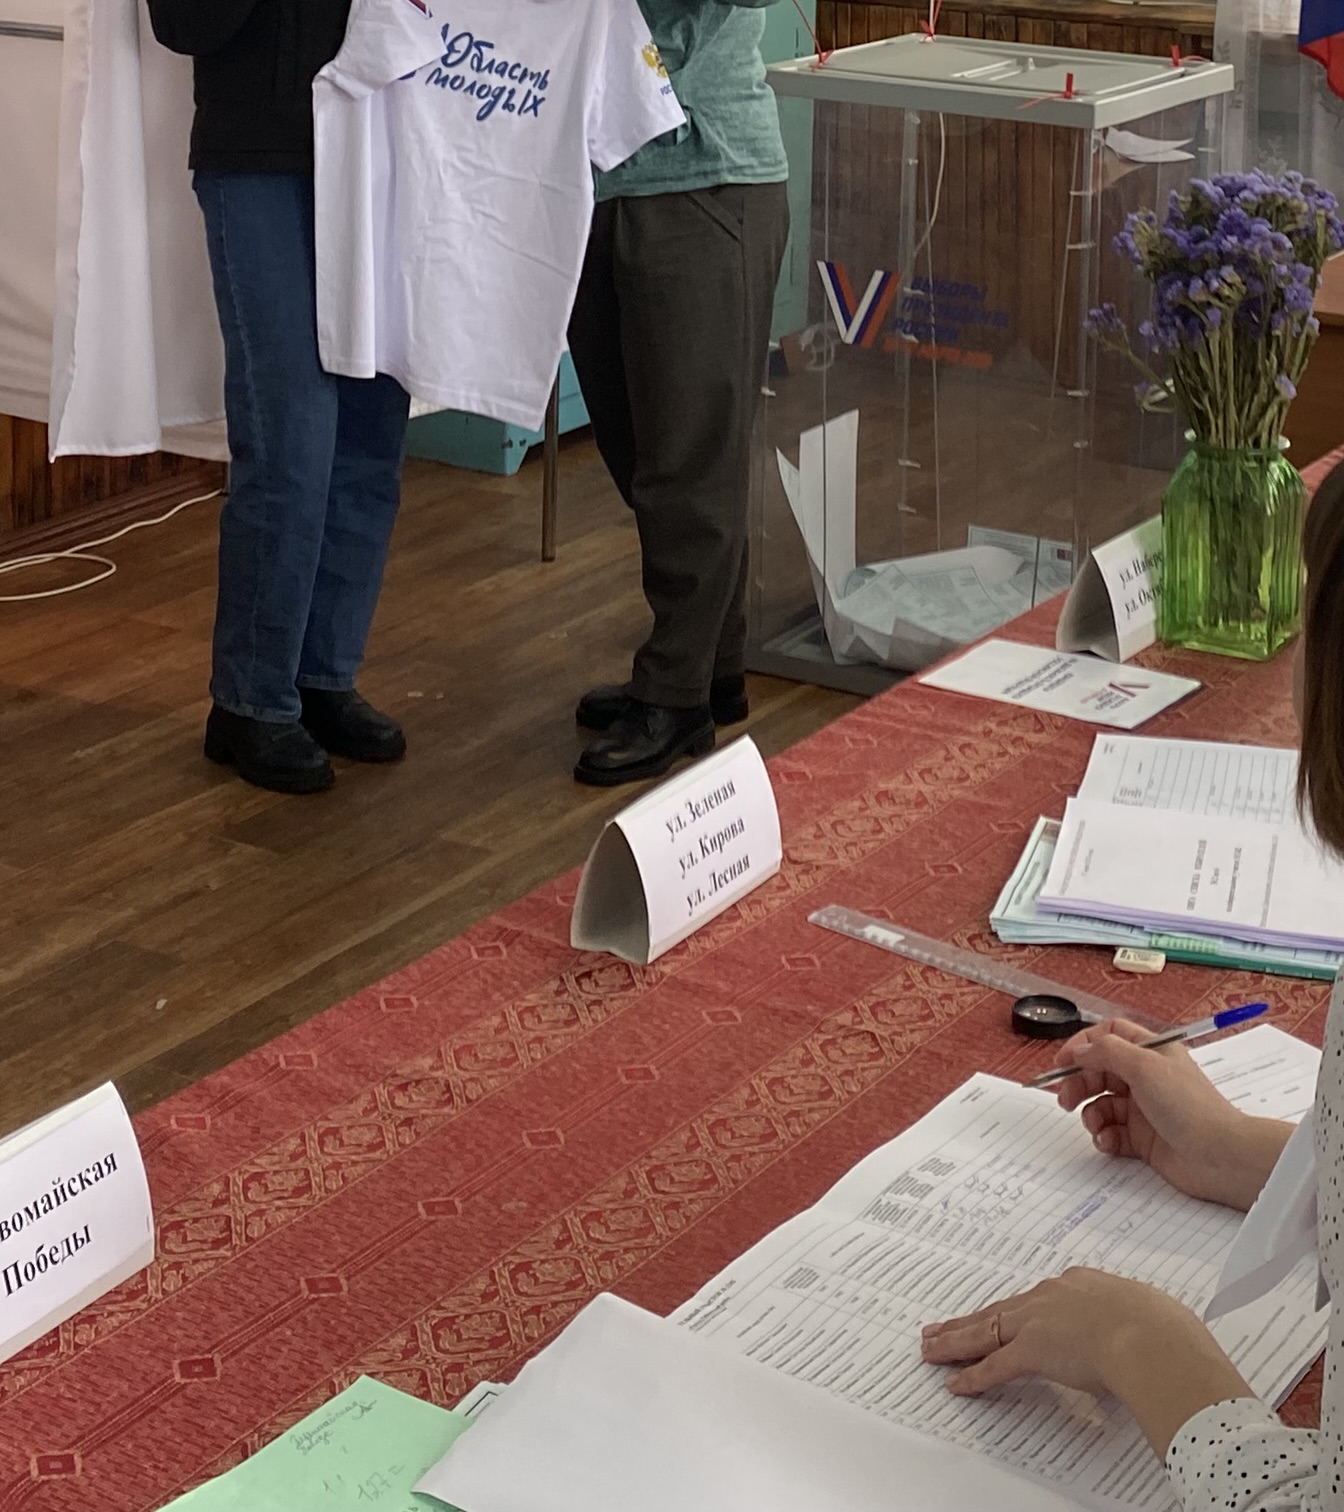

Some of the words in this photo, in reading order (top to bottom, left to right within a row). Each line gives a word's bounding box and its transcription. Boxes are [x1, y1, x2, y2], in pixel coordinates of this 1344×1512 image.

[441, 32, 550, 90] Область
[425, 67, 545, 121] молодых
[665, 813, 687, 843] ул.
[685, 779, 736, 823] Зеленая
[679, 850, 699, 880] ул.
[698, 816, 745, 859] Кирова
[686, 887, 706, 916] ул.
[708, 854, 750, 897] Лесная
[2, 1224, 92, 1297] Победы
